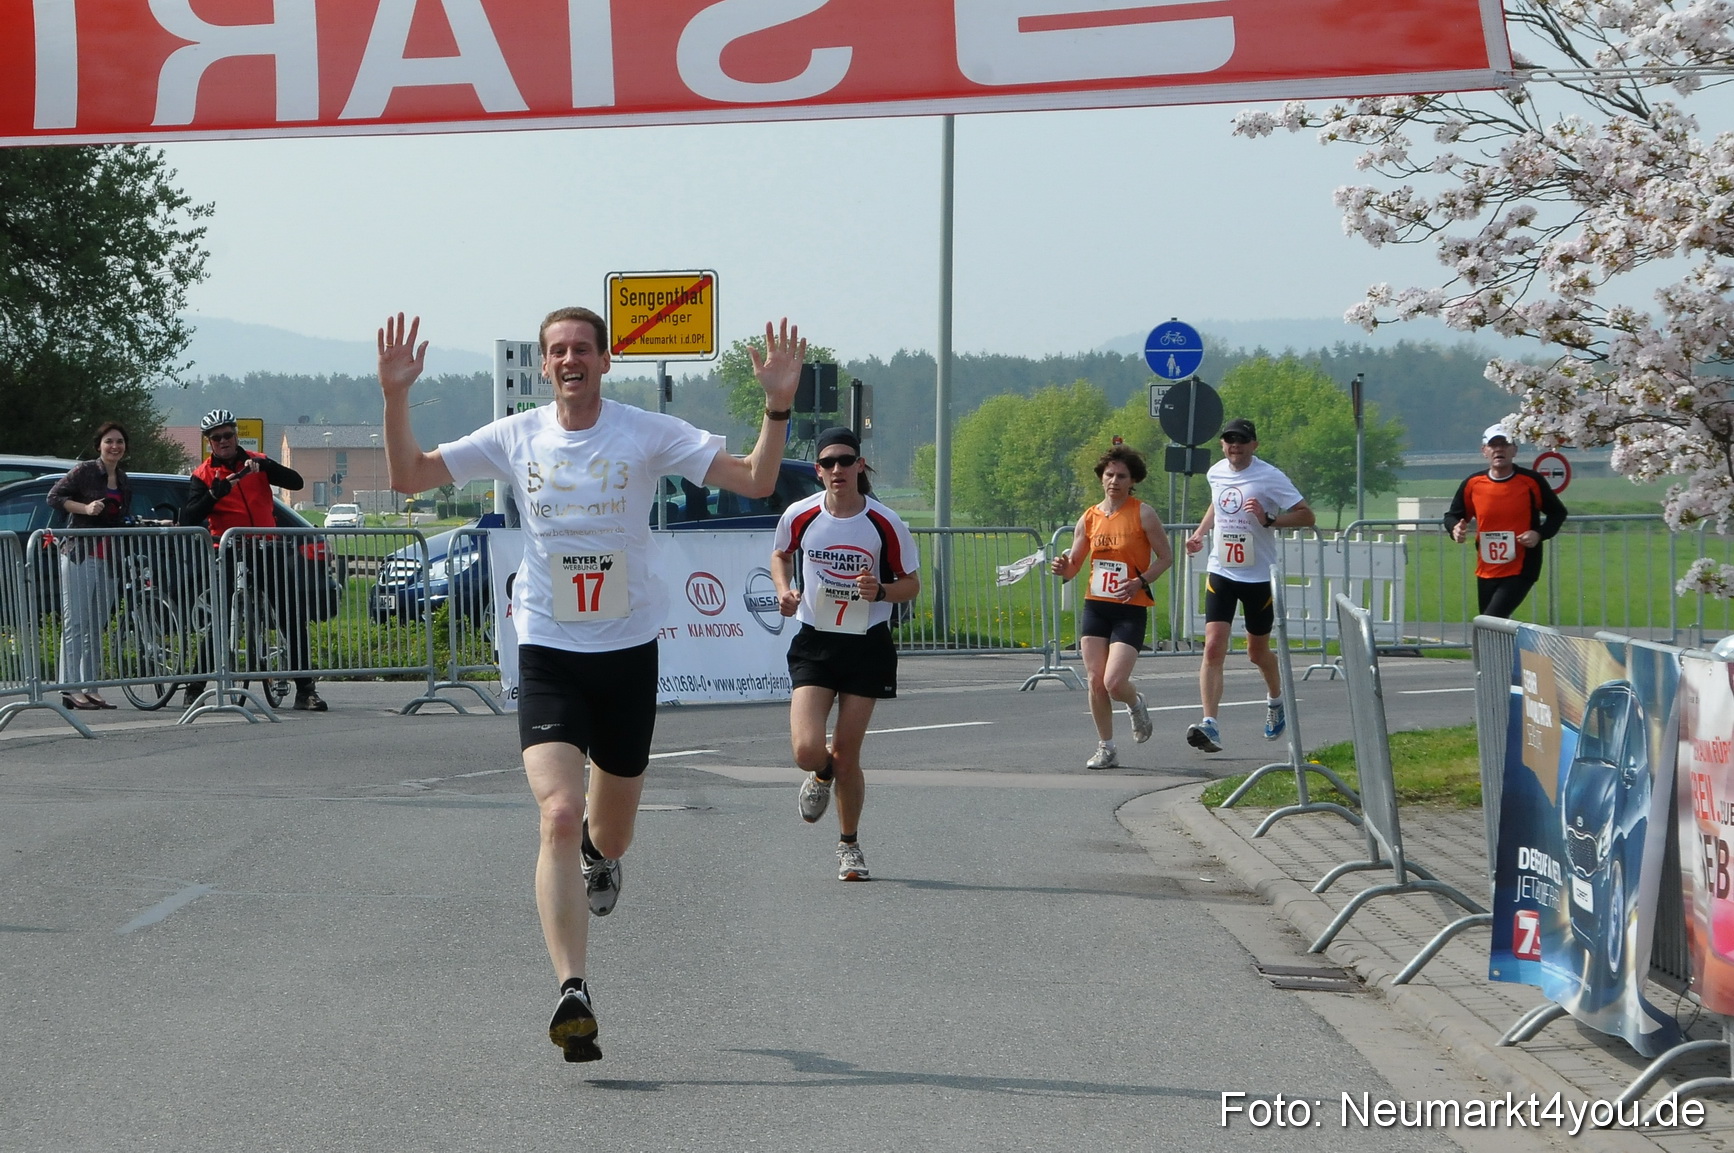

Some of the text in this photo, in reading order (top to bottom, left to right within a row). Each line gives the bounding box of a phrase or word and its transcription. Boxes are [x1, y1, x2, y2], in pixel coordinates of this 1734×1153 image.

[619, 286, 704, 311] Sengenthal
[631, 312, 692, 326] am Anger
[617, 335, 637, 344] Kreis
[640, 334, 677, 344] Neumarkt
[527, 458, 629, 493] BC 93
[529, 496, 628, 518] Neumarkt
[562, 555, 597, 564] MEYER
[808, 549, 862, 563] GERHART
[1224, 543, 1245, 564] 76
[1489, 541, 1508, 561] 62
[572, 571, 605, 613] 17
[825, 587, 850, 596] MEYER
[1102, 571, 1119, 594] 15
[691, 583, 721, 606] KIA
[748, 595, 781, 608] NISSA
[834, 600, 849, 627] 7
[657, 627, 678, 639] AT
[687, 622, 744, 638] KIA MOTORS
